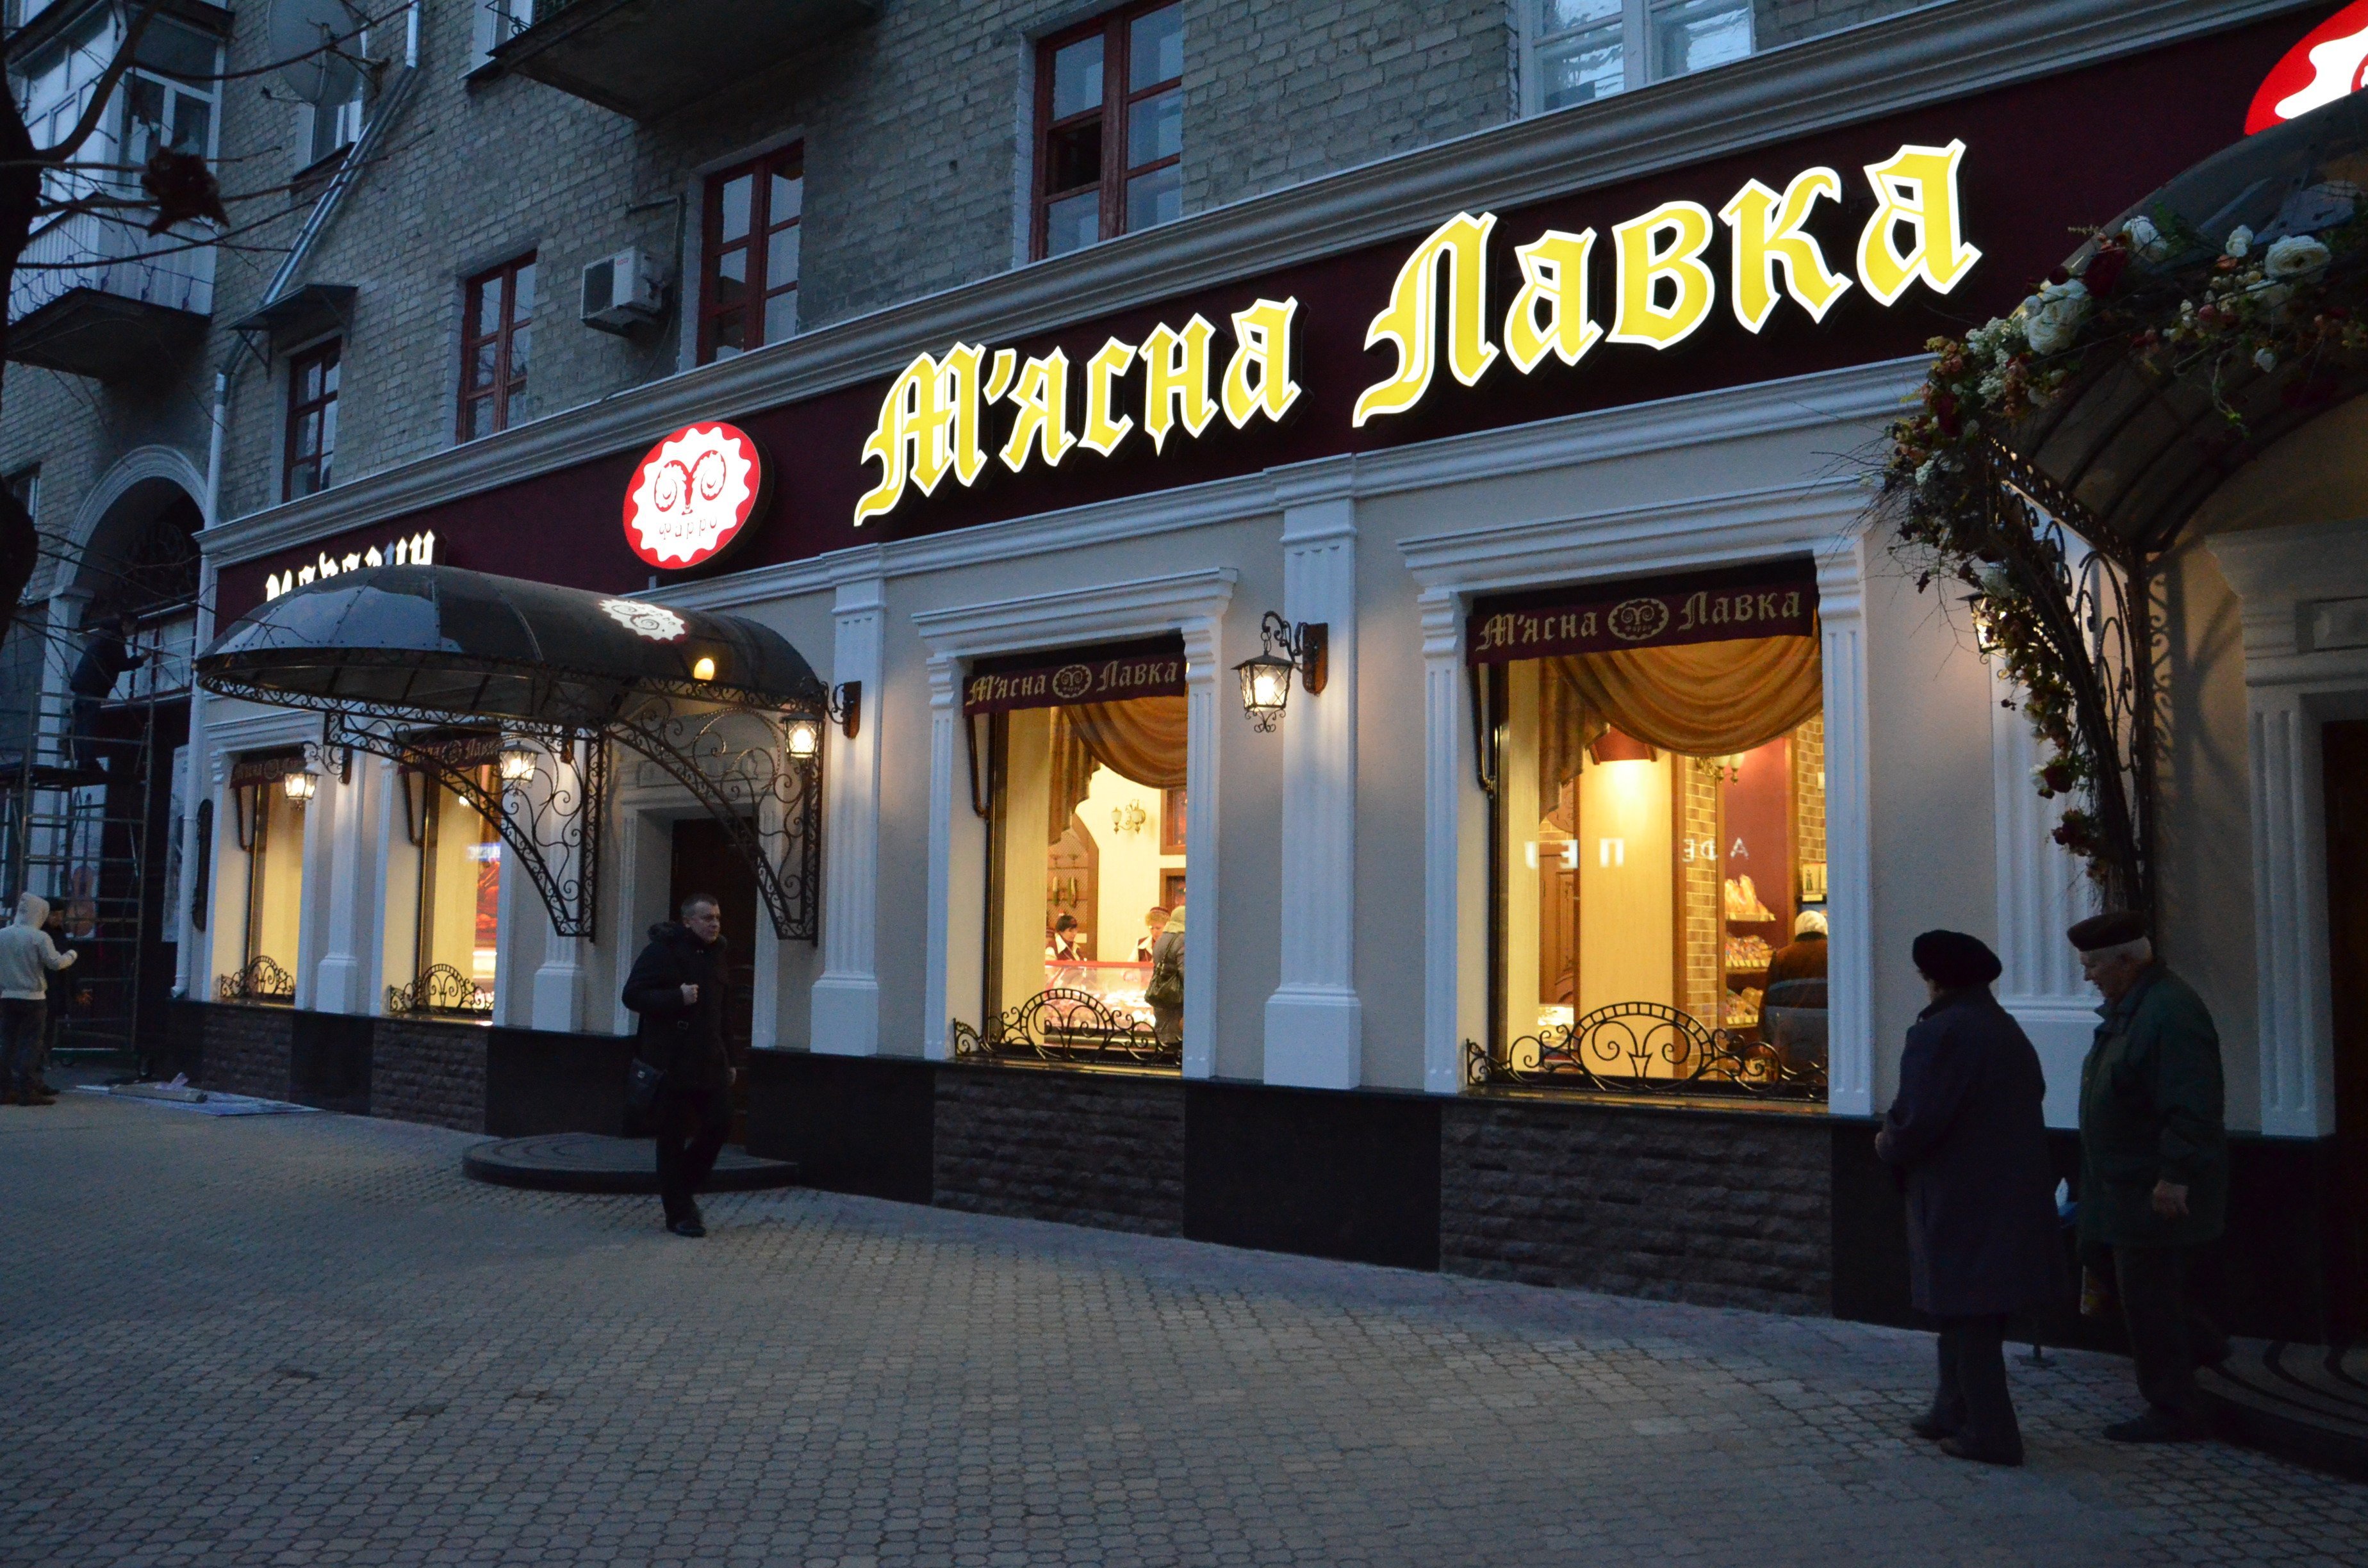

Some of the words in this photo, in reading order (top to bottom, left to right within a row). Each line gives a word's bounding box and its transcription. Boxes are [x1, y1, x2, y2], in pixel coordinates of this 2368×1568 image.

[853, 296, 1301, 528] М'ясна
[1352, 138, 1984, 428] Лавка
[1476, 612, 1599, 651] М'ясна
[1677, 591, 1801, 630] Лавка
[966, 674, 1046, 705] М'ясна
[1096, 660, 1178, 692] Лавка
